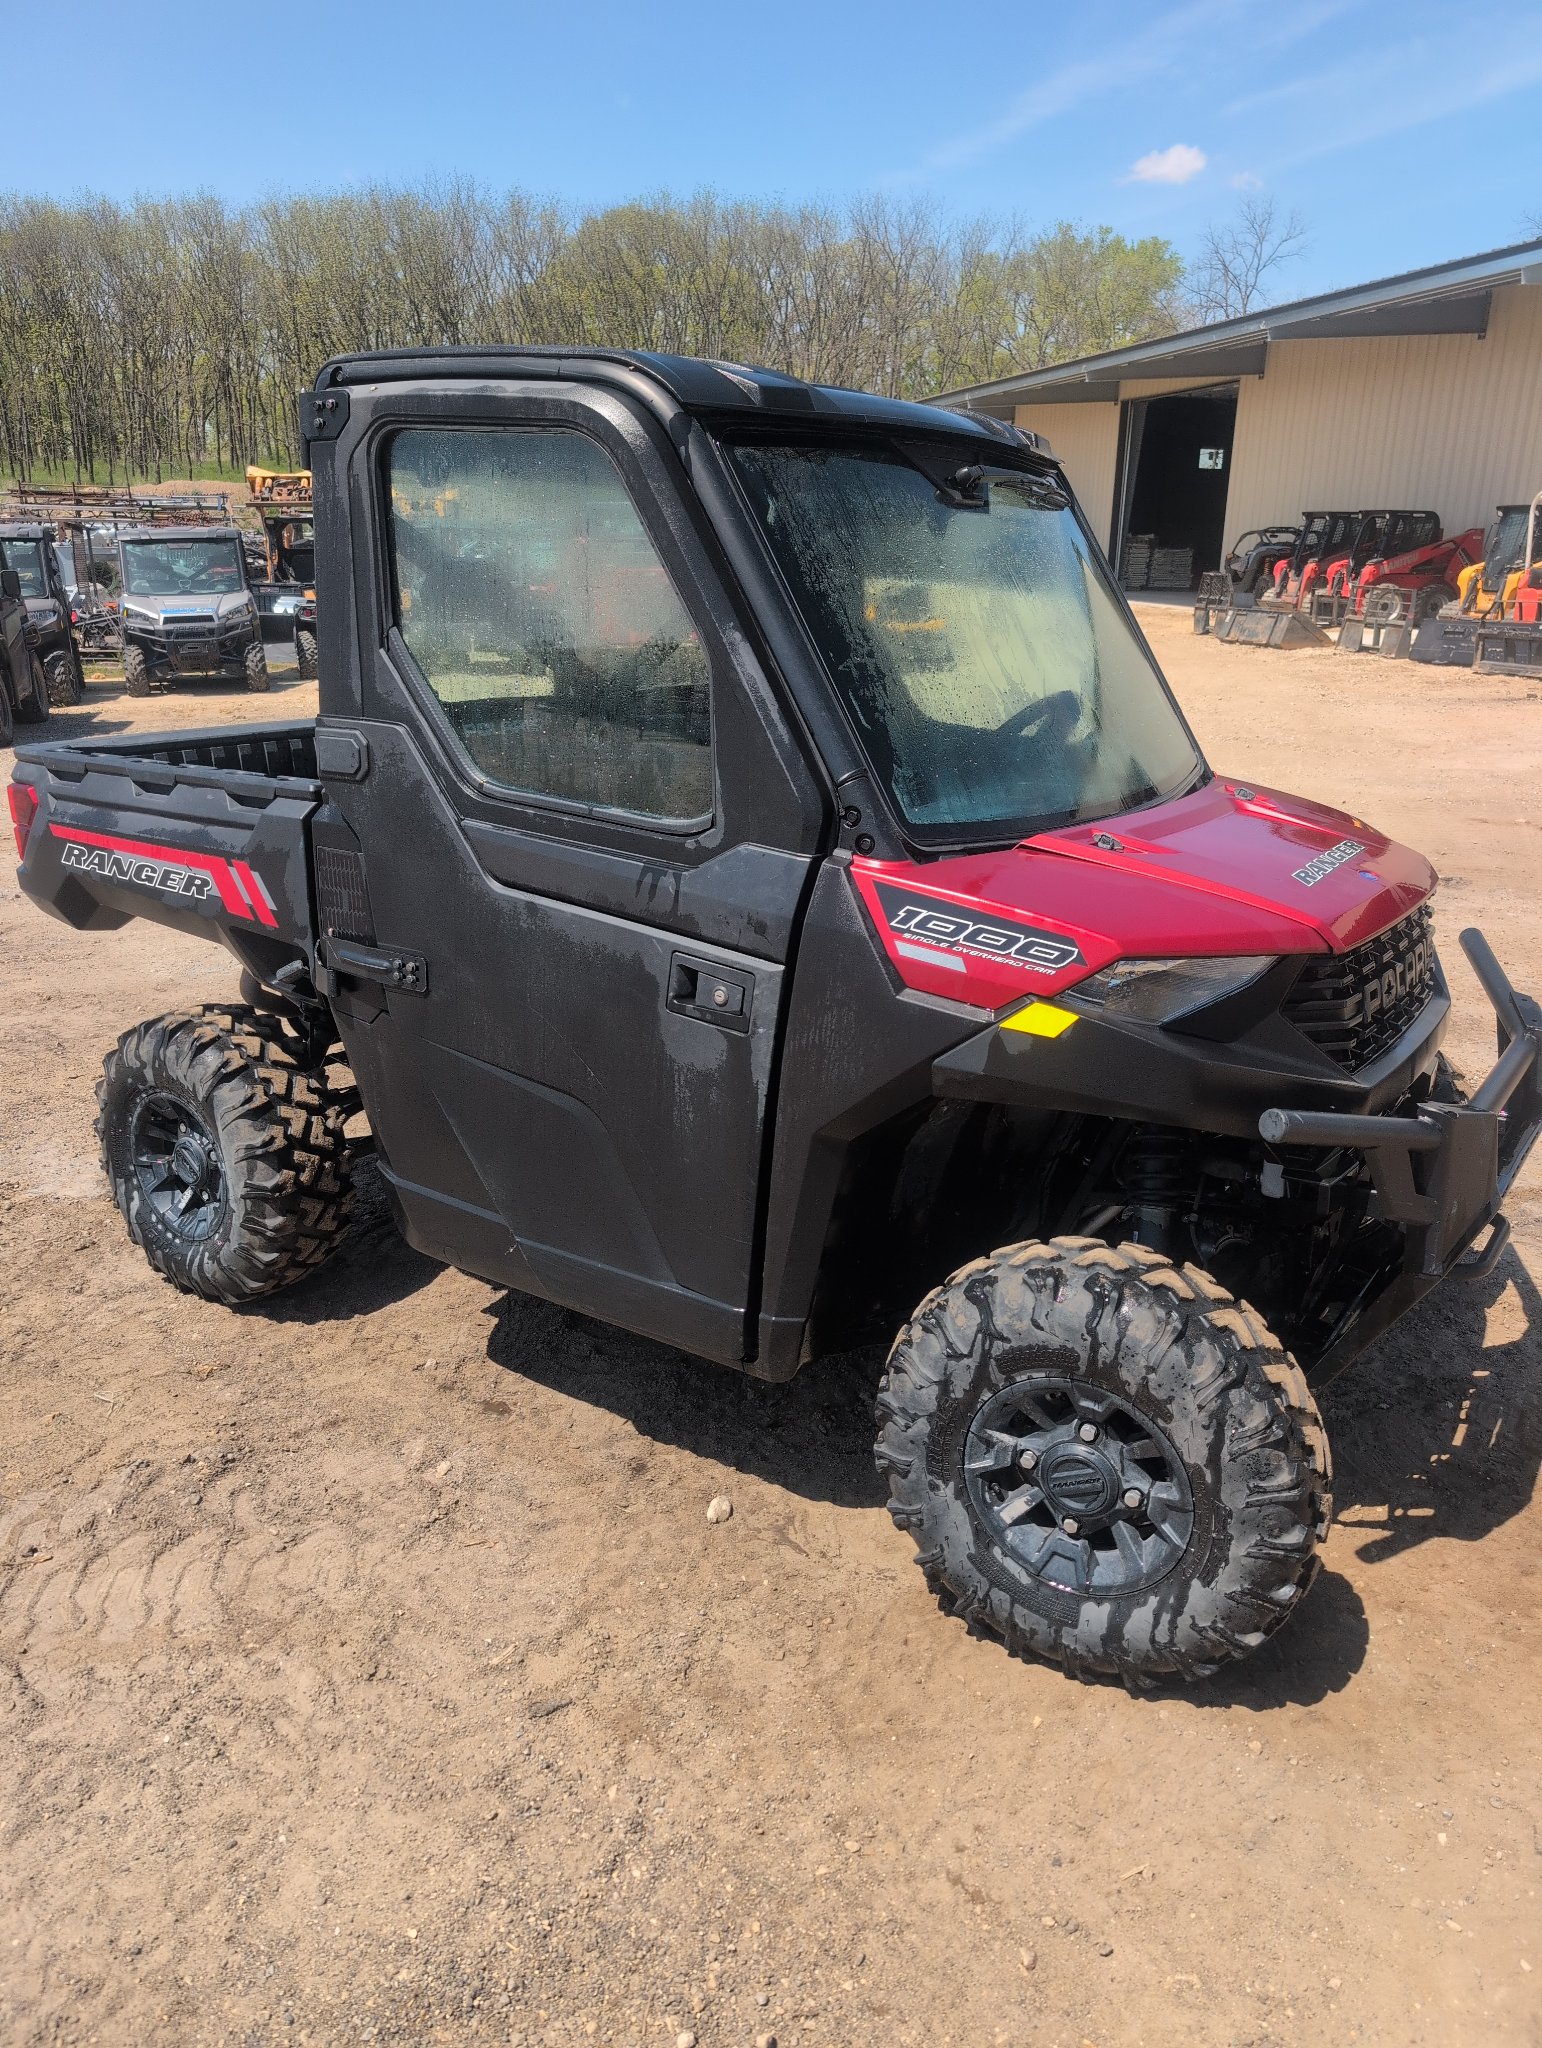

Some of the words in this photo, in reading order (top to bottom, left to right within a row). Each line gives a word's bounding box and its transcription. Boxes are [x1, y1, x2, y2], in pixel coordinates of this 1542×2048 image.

[61, 842, 212, 900] RANGER
[1291, 839, 1367, 887] RANGER
[889, 905, 1079, 968] 1000
[902, 932, 950, 949] SINGLE
[952, 946, 1024, 967] OVERHEAD
[1024, 964, 1056, 976] CAM
[1363, 937, 1436, 1024] POLARIS
